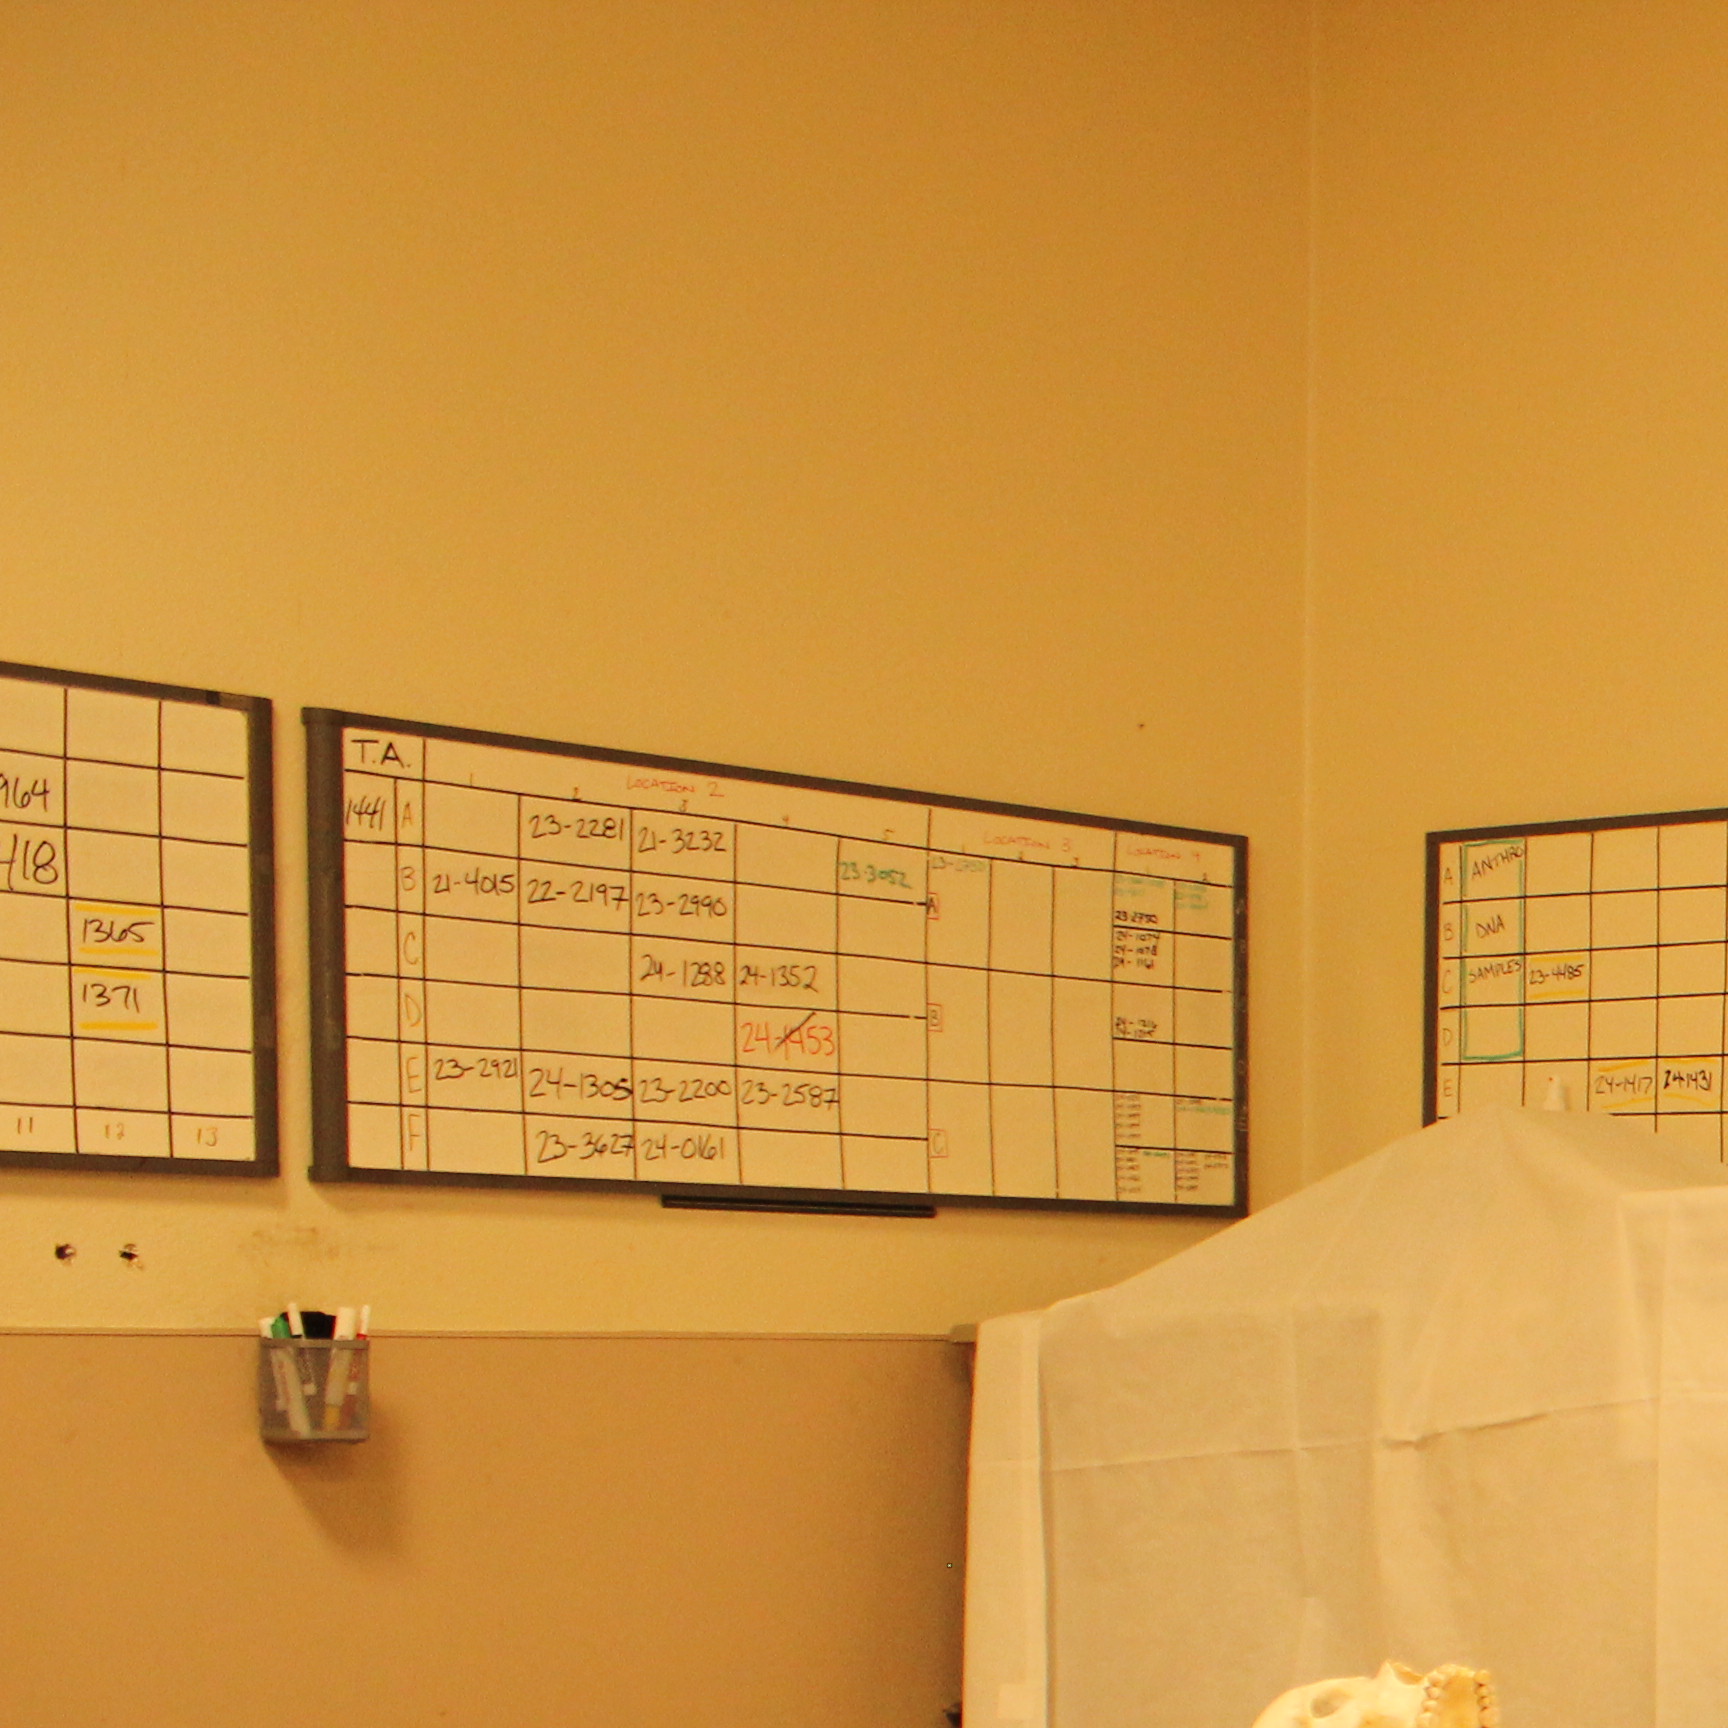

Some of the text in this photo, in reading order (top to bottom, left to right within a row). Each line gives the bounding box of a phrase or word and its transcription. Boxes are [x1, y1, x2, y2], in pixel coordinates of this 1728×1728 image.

[401, 802, 413, 829] A
[528, 814, 625, 841] 23-2281
[526, 878, 630, 911] 22-2197
[636, 893, 727, 917] 23-2990
[82, 918, 155, 943] 1365
[1475, 914, 1506, 939] DNA
[403, 932, 419, 965] C
[738, 964, 819, 993] 24-1352
[1467, 958, 1523, 984] SAMPLES
[81, 983, 140, 1013] 1371
[407, 1057, 422, 1094] E
[639, 1078, 733, 1103] 23-2200
[740, 1080, 840, 1111] 23-2587
[196, 1127, 218, 1147] 13
